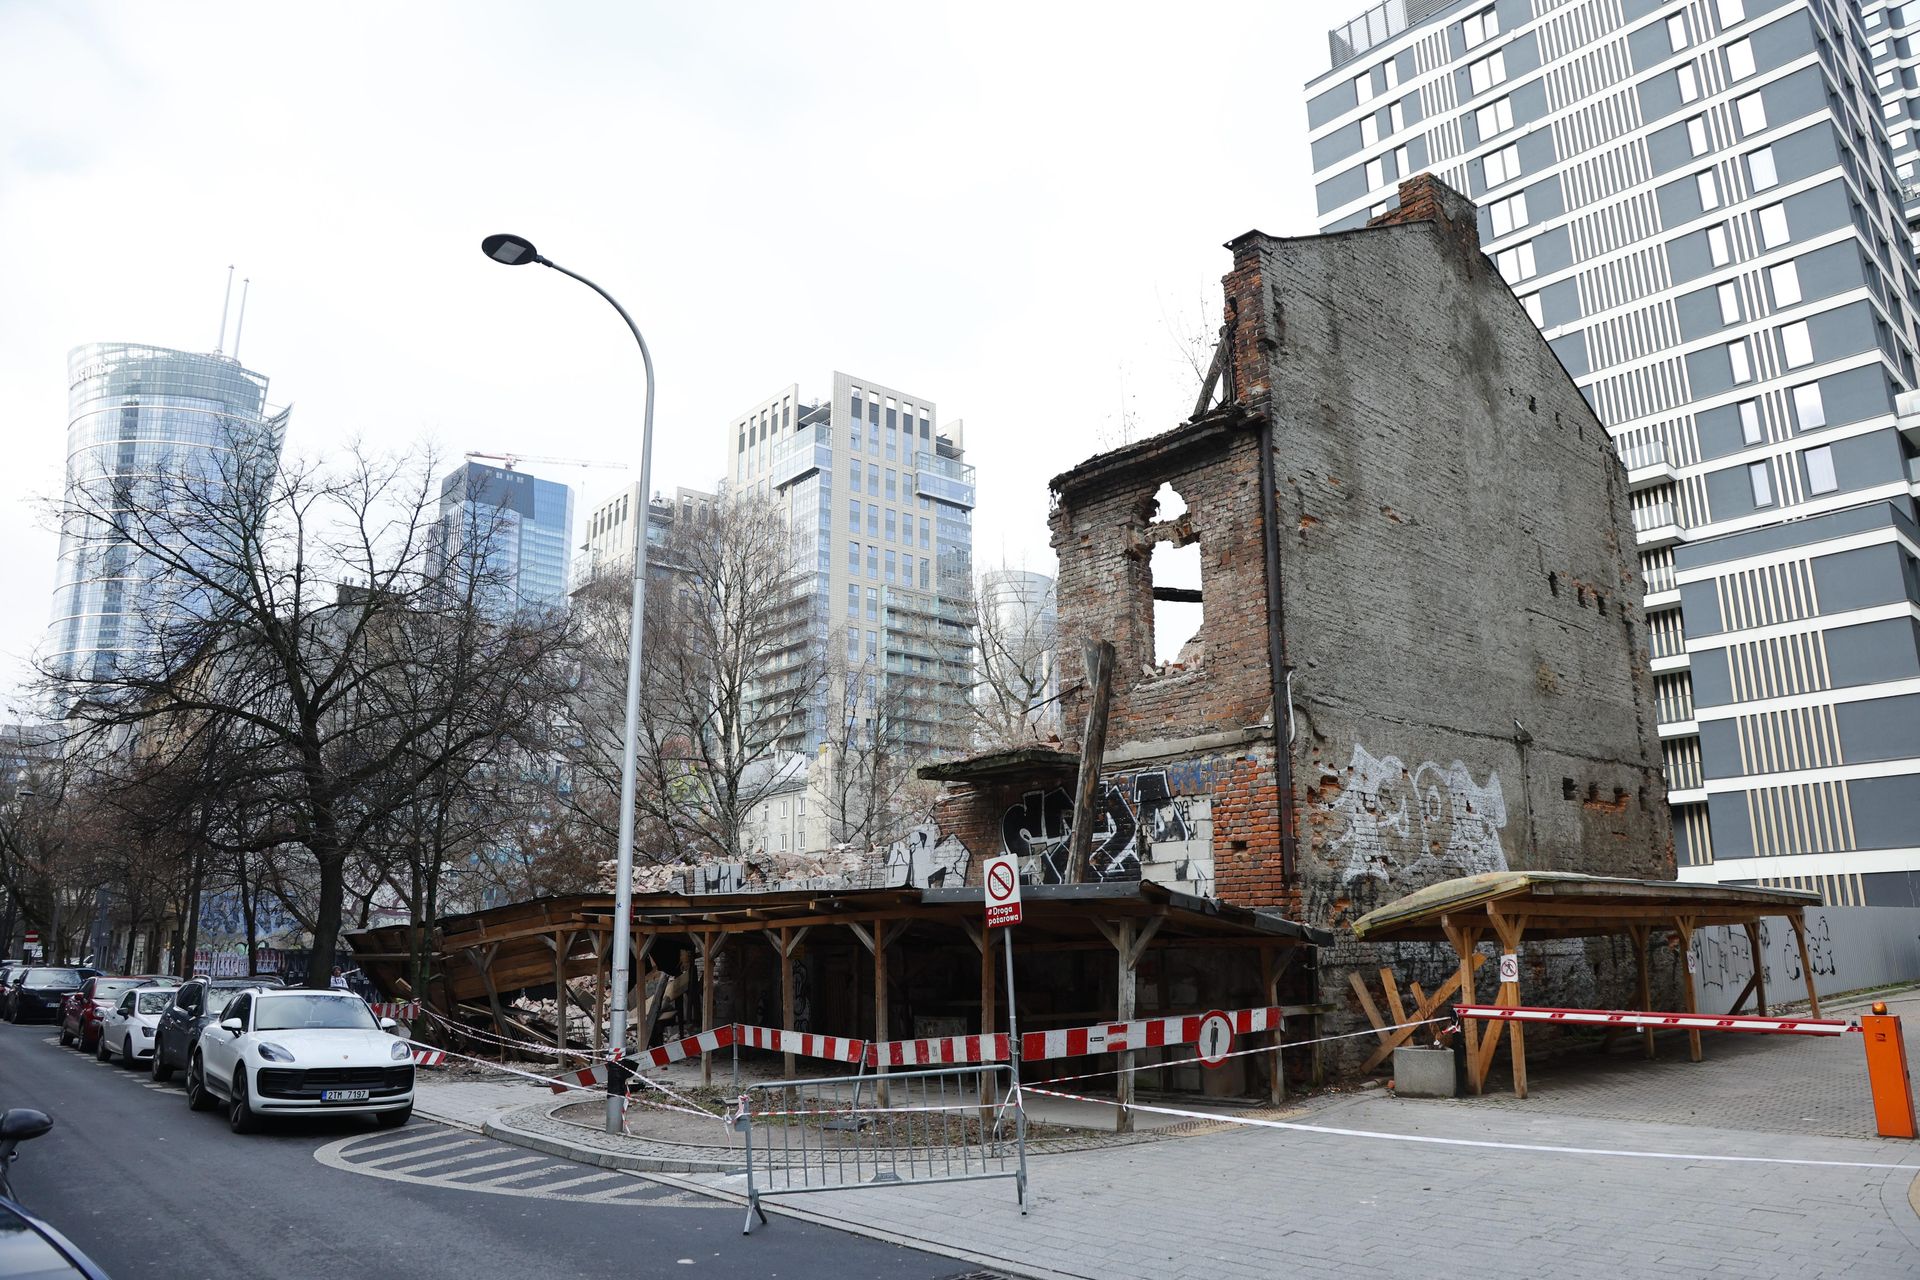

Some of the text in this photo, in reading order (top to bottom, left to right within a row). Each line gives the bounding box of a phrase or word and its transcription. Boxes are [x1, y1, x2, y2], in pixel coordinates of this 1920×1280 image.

[992, 906, 1013, 916] Droga
[988, 914, 1019, 927] pożarowa
[328, 1090, 366, 1100] 2TM 7197
